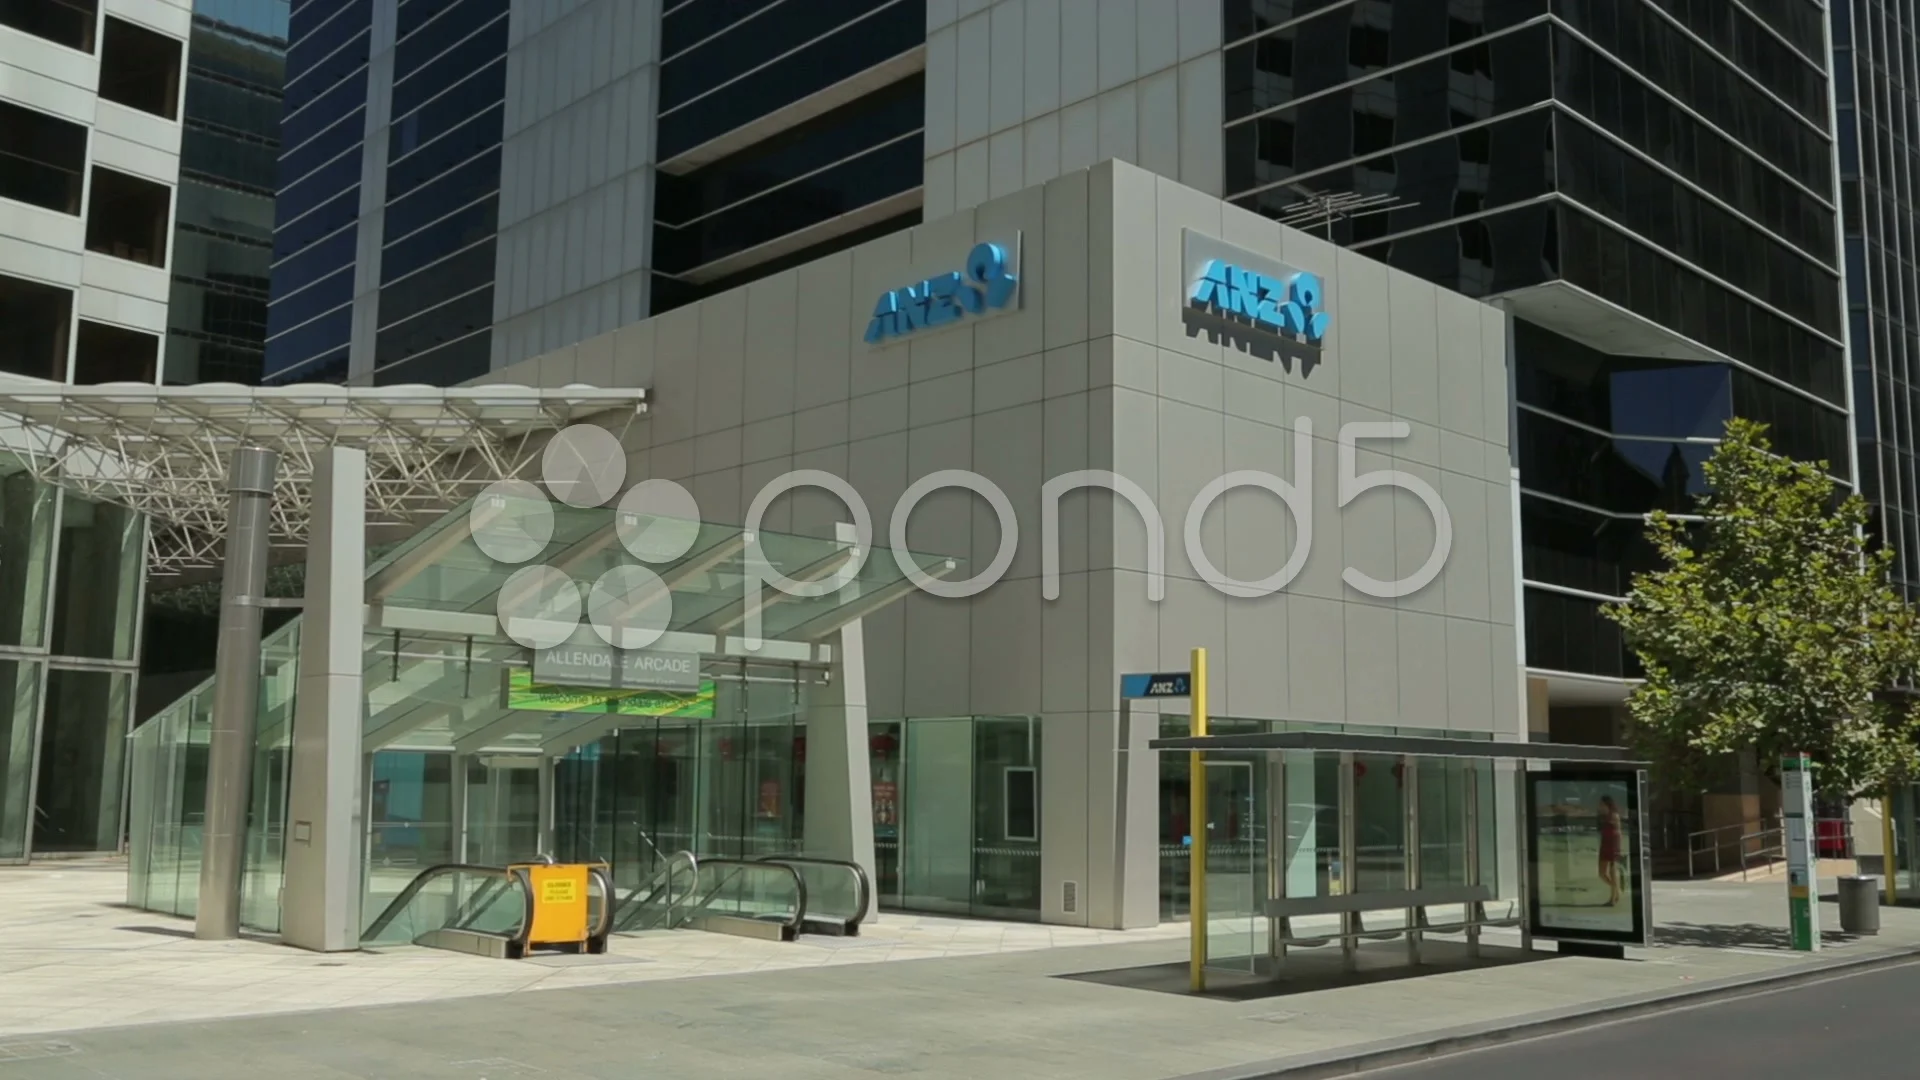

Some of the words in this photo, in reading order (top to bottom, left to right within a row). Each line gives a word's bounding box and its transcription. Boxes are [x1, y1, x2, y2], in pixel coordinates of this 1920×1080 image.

[864, 269, 963, 344] ANZ
[1193, 258, 1287, 328] ANZ
[634, 656, 691, 673] ARCADE
[1149, 681, 1174, 694] ANZ
